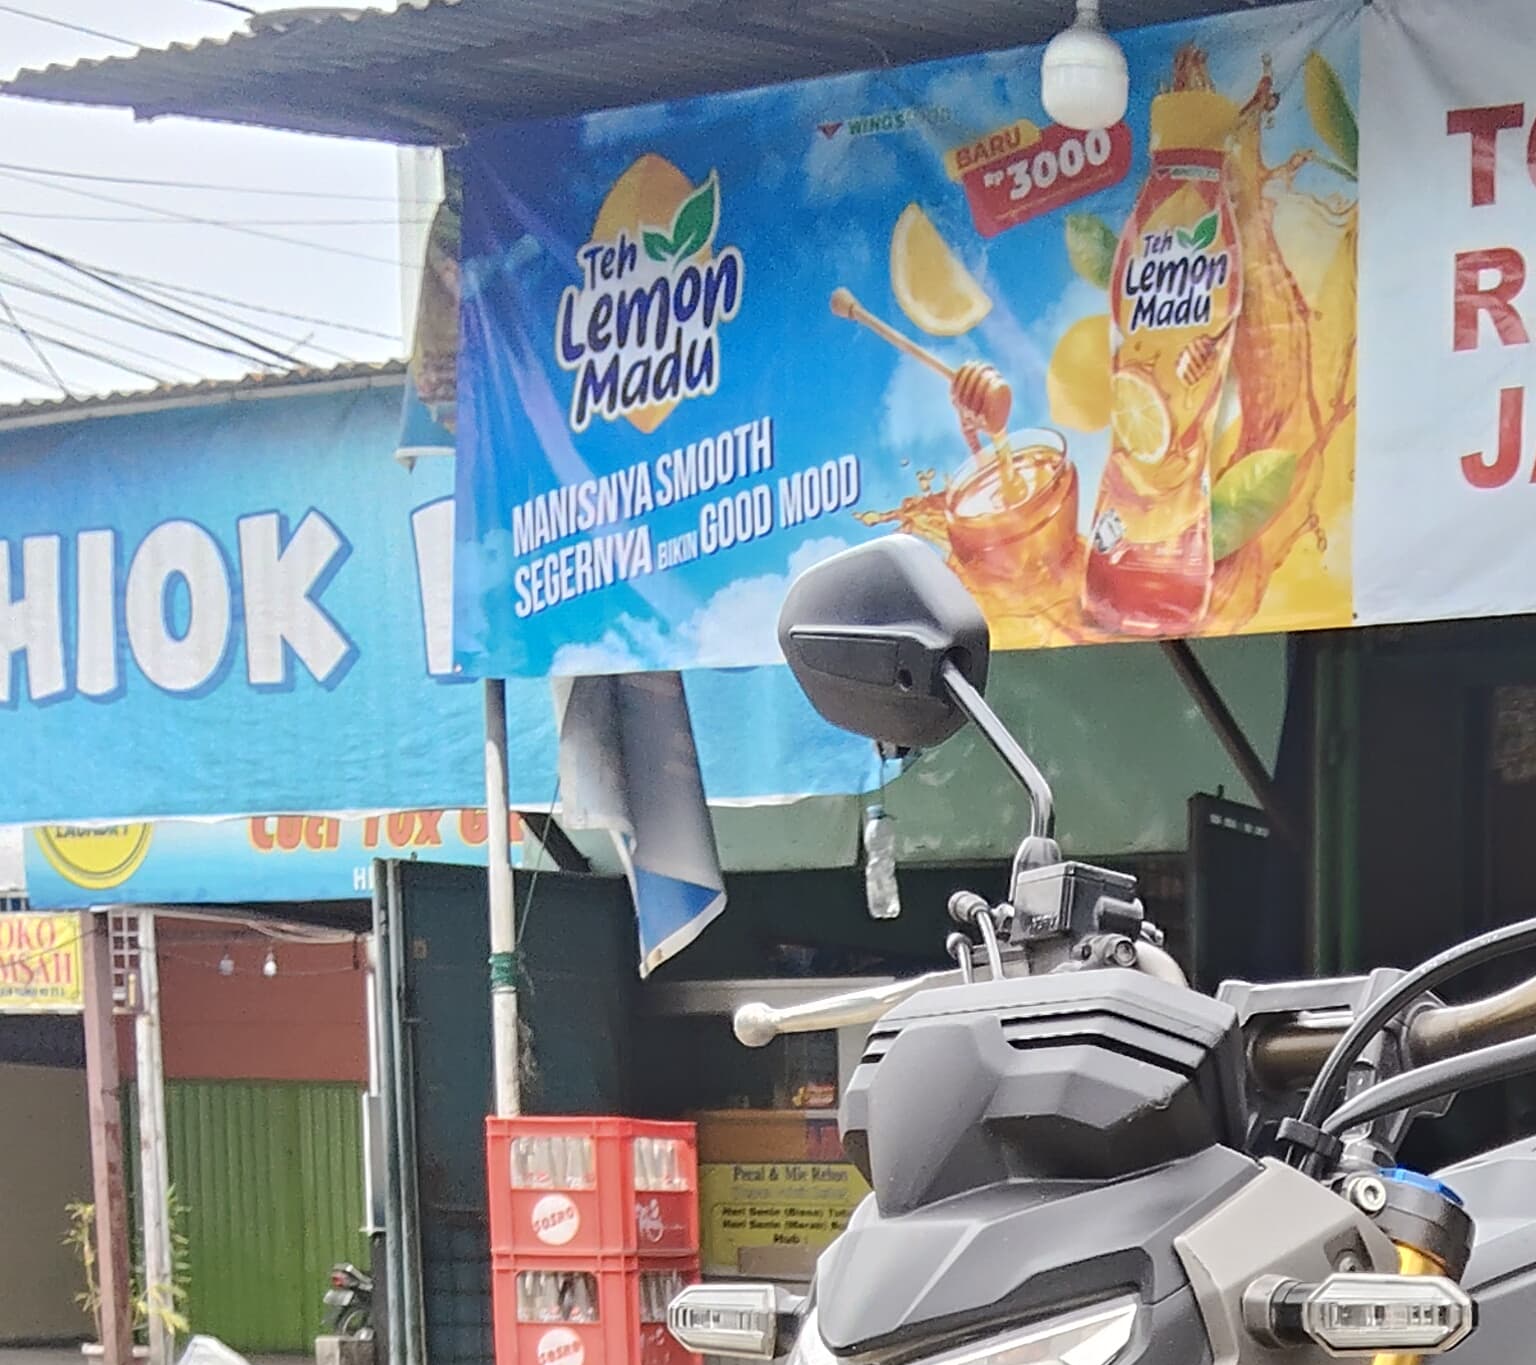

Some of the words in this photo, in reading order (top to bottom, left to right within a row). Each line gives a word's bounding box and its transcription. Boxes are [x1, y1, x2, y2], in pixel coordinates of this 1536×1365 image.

[955, 127, 1022, 169] BARU
[1007, 129, 1113, 201] 3000
[582, 241, 637, 291] Teh
[1143, 233, 1173, 257] Teh
[1125, 250, 1228, 294] Lemon
[560, 253, 740, 363] Lemon
[1130, 287, 1211, 331] Madu
[575, 327, 715, 425] Madu
[512, 461, 654, 557] MANISNYA
[655, 416, 774, 507] SMOOTH
[514, 524, 653, 619] SEGERNYA
[657, 530, 699, 571] BIKIN
[700, 484, 773, 555] GOOD
[778, 454, 861, 530] MOOD
[533, 1206, 576, 1234] SOSRO
